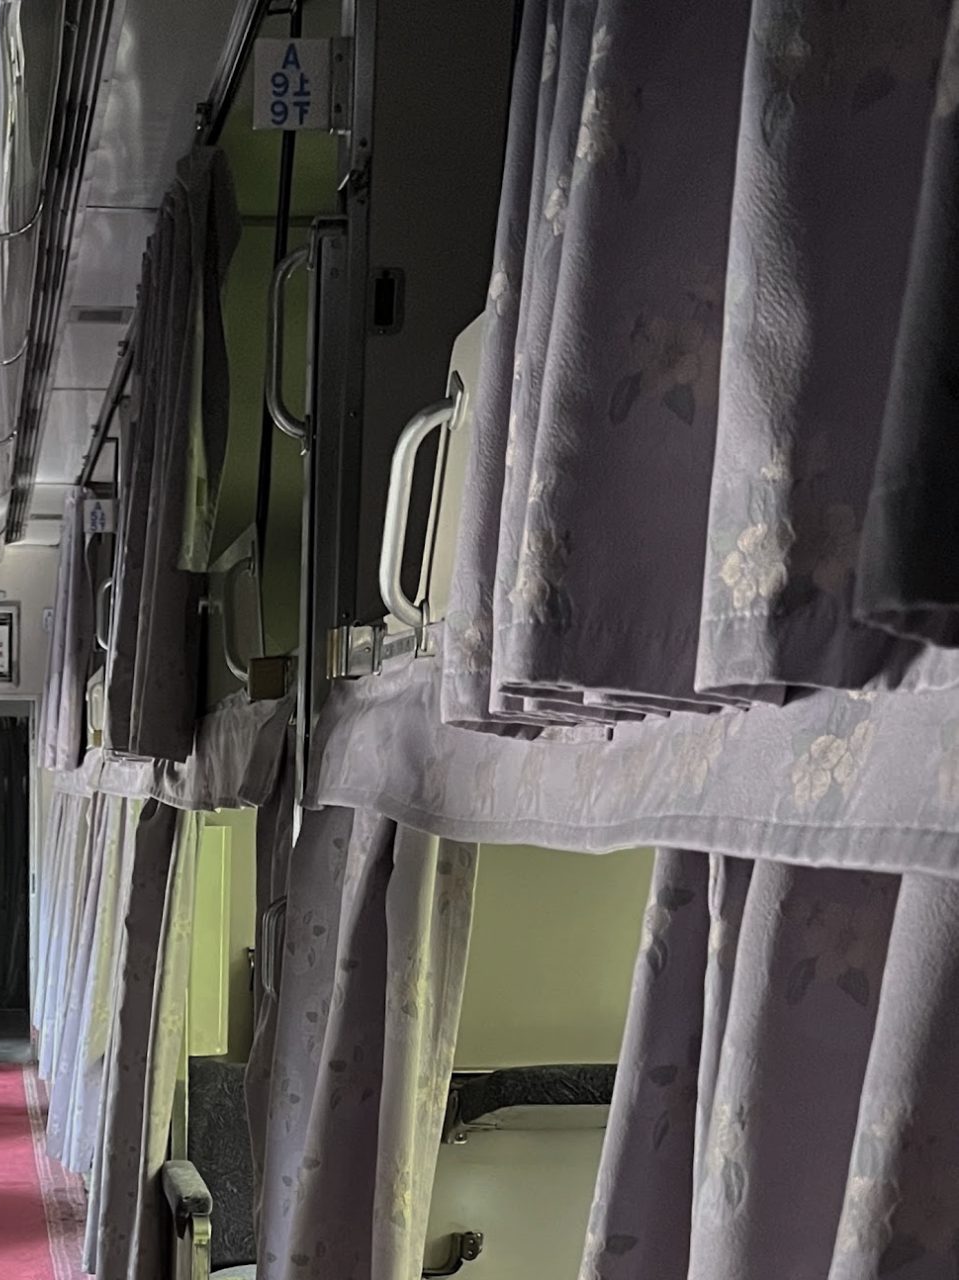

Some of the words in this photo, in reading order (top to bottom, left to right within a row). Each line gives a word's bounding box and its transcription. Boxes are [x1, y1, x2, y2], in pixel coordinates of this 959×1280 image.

[282, 43, 300, 69] A
[271, 72, 311, 97] 9上
[270, 100, 310, 125] 9下
